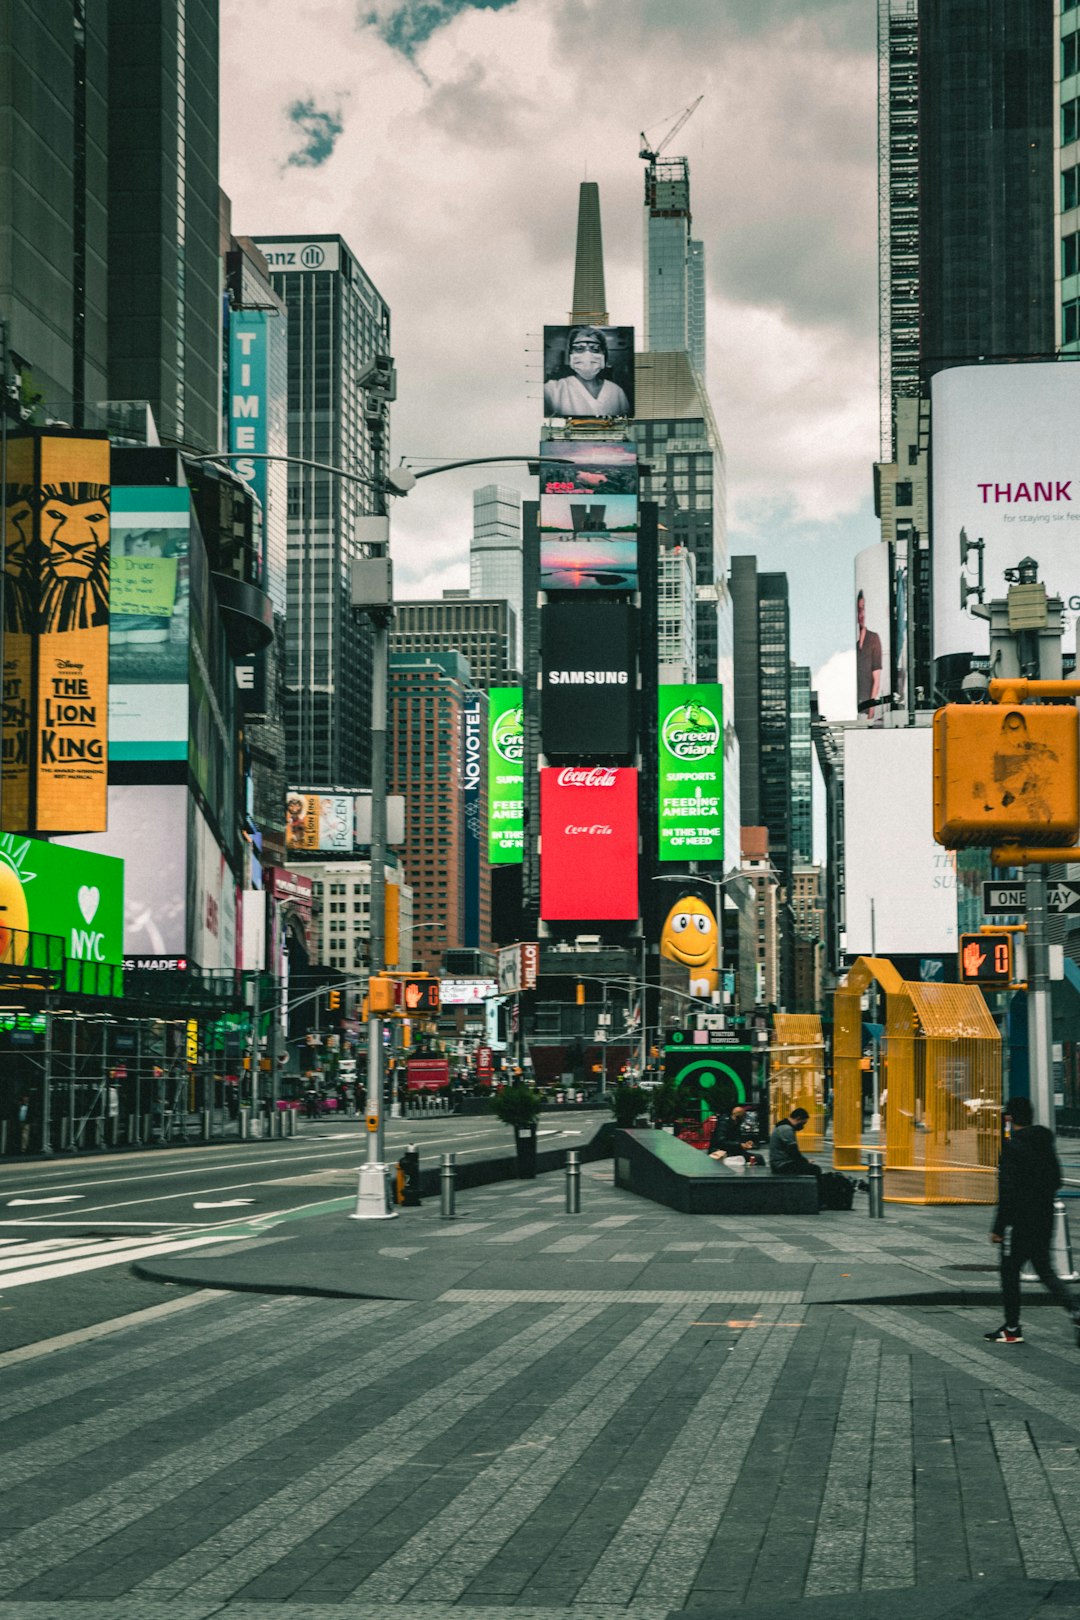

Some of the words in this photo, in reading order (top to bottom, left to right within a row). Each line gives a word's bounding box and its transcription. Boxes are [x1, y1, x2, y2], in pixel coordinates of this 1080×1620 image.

[265, 252, 296, 265] anz
[233, 332, 259, 481] TIMES
[977, 481, 1072, 503] THANK
[1004, 514, 1016, 523] for
[1019, 514, 1050, 524] staying
[1053, 512, 1064, 521] six
[55, 659, 84, 669] Disney
[548, 671, 628, 684] SAMSUNG
[52, 678, 88, 695] THE
[669, 730, 716, 742] Green
[464, 702, 481, 790] NOVOTEL
[675, 742, 718, 756] Giant
[666, 772, 717, 781] SUPPORTS
[664, 798, 718, 807] FEEDING
[662, 807, 719, 816] AMERICA
[332, 798, 348, 847] FROZEN
[662, 828, 673, 836] IN
[674, 828, 696, 836] THIS
[697, 827, 720, 836] TIME
[670, 837, 684, 846] OF
[686, 837, 712, 846] NEED
[998, 892, 1026, 904] ONE
[71, 928, 105, 961] NYC
[138, 960, 177, 970] MADE
[995, 944, 1008, 973] 0
[428, 986, 438, 1006] 0
